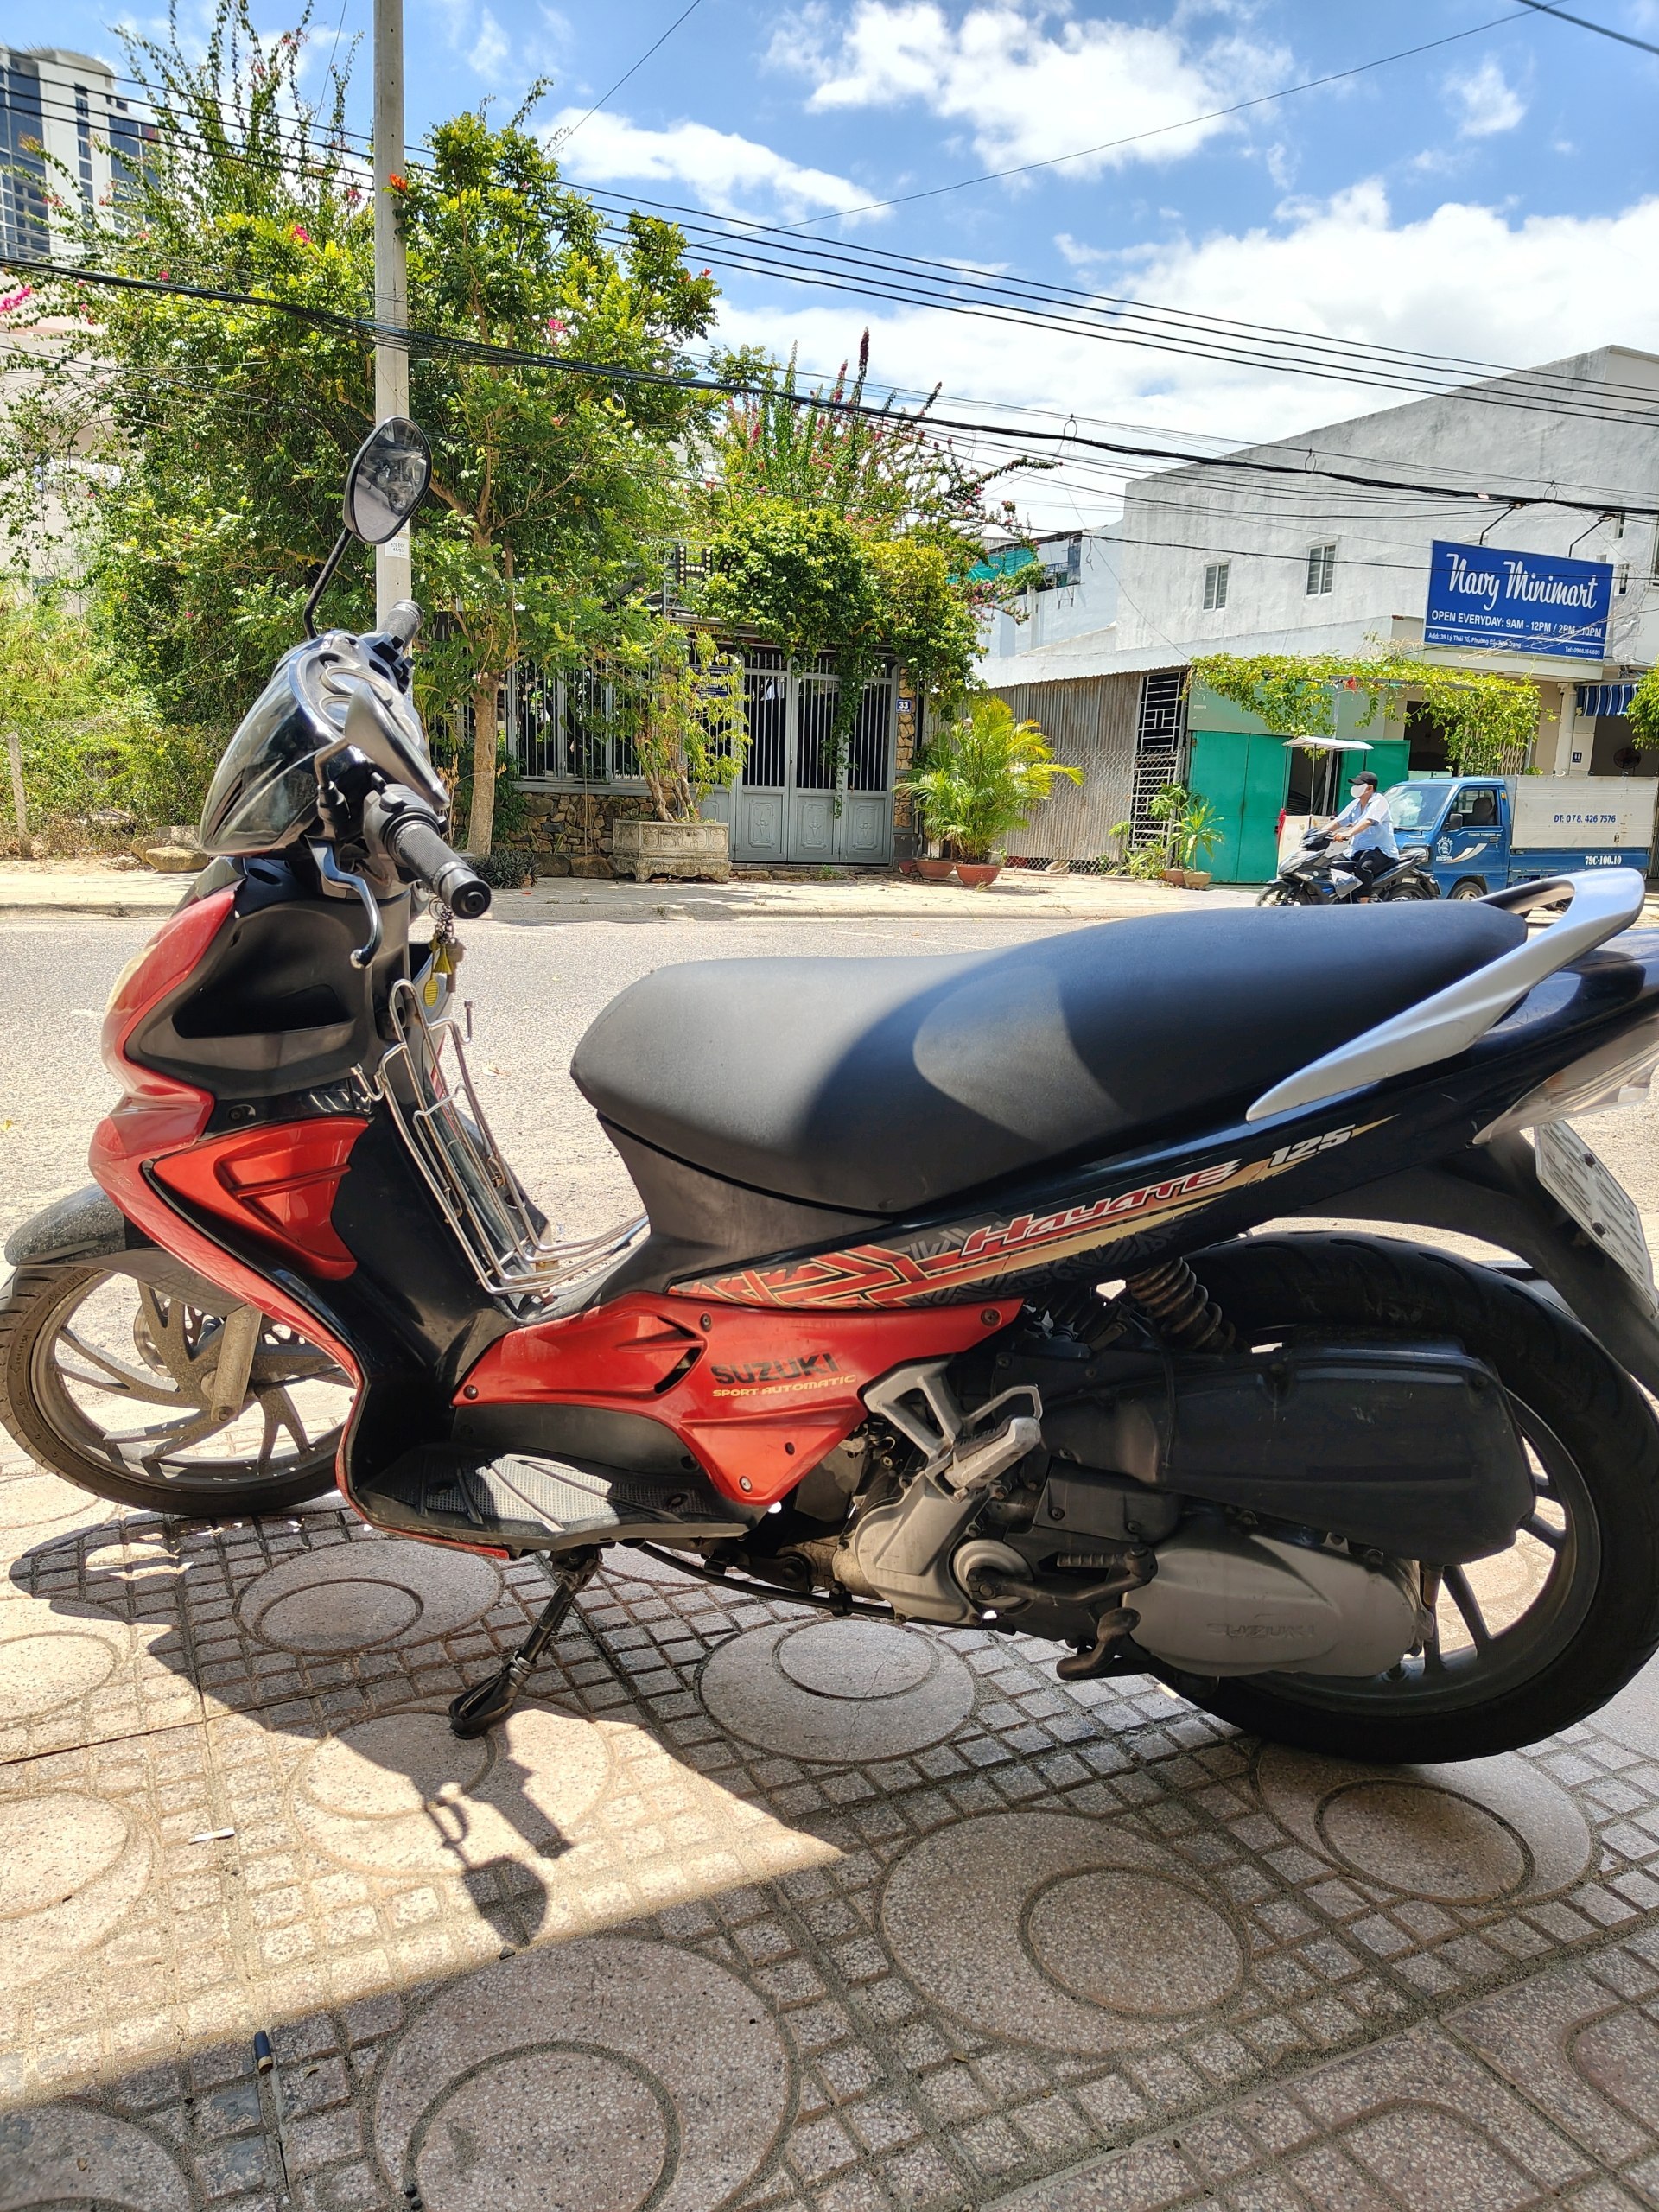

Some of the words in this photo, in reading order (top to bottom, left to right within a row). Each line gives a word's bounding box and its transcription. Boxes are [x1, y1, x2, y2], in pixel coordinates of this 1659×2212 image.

[1446, 553, 1501, 611] Navy
[1503, 561, 1599, 609] Minimart
[1431, 610, 1457, 622] OPEN
[1458, 613, 1504, 627] EVERYDAY:
[1506, 618, 1524, 630] 9AM
[1531, 621, 1552, 632] 12PM
[1559, 625, 1575, 635] 2PM
[899, 701, 909, 709] 33
[1585, 814, 1599, 823] 426
[1599, 814, 1617, 823] 7576
[1269, 1124, 1356, 1167] 125
[710, 1352, 840, 1384] SUZUKI
[713, 1388, 760, 1397] SPORT
[761, 1375, 857, 1395] AUTOMATIC
